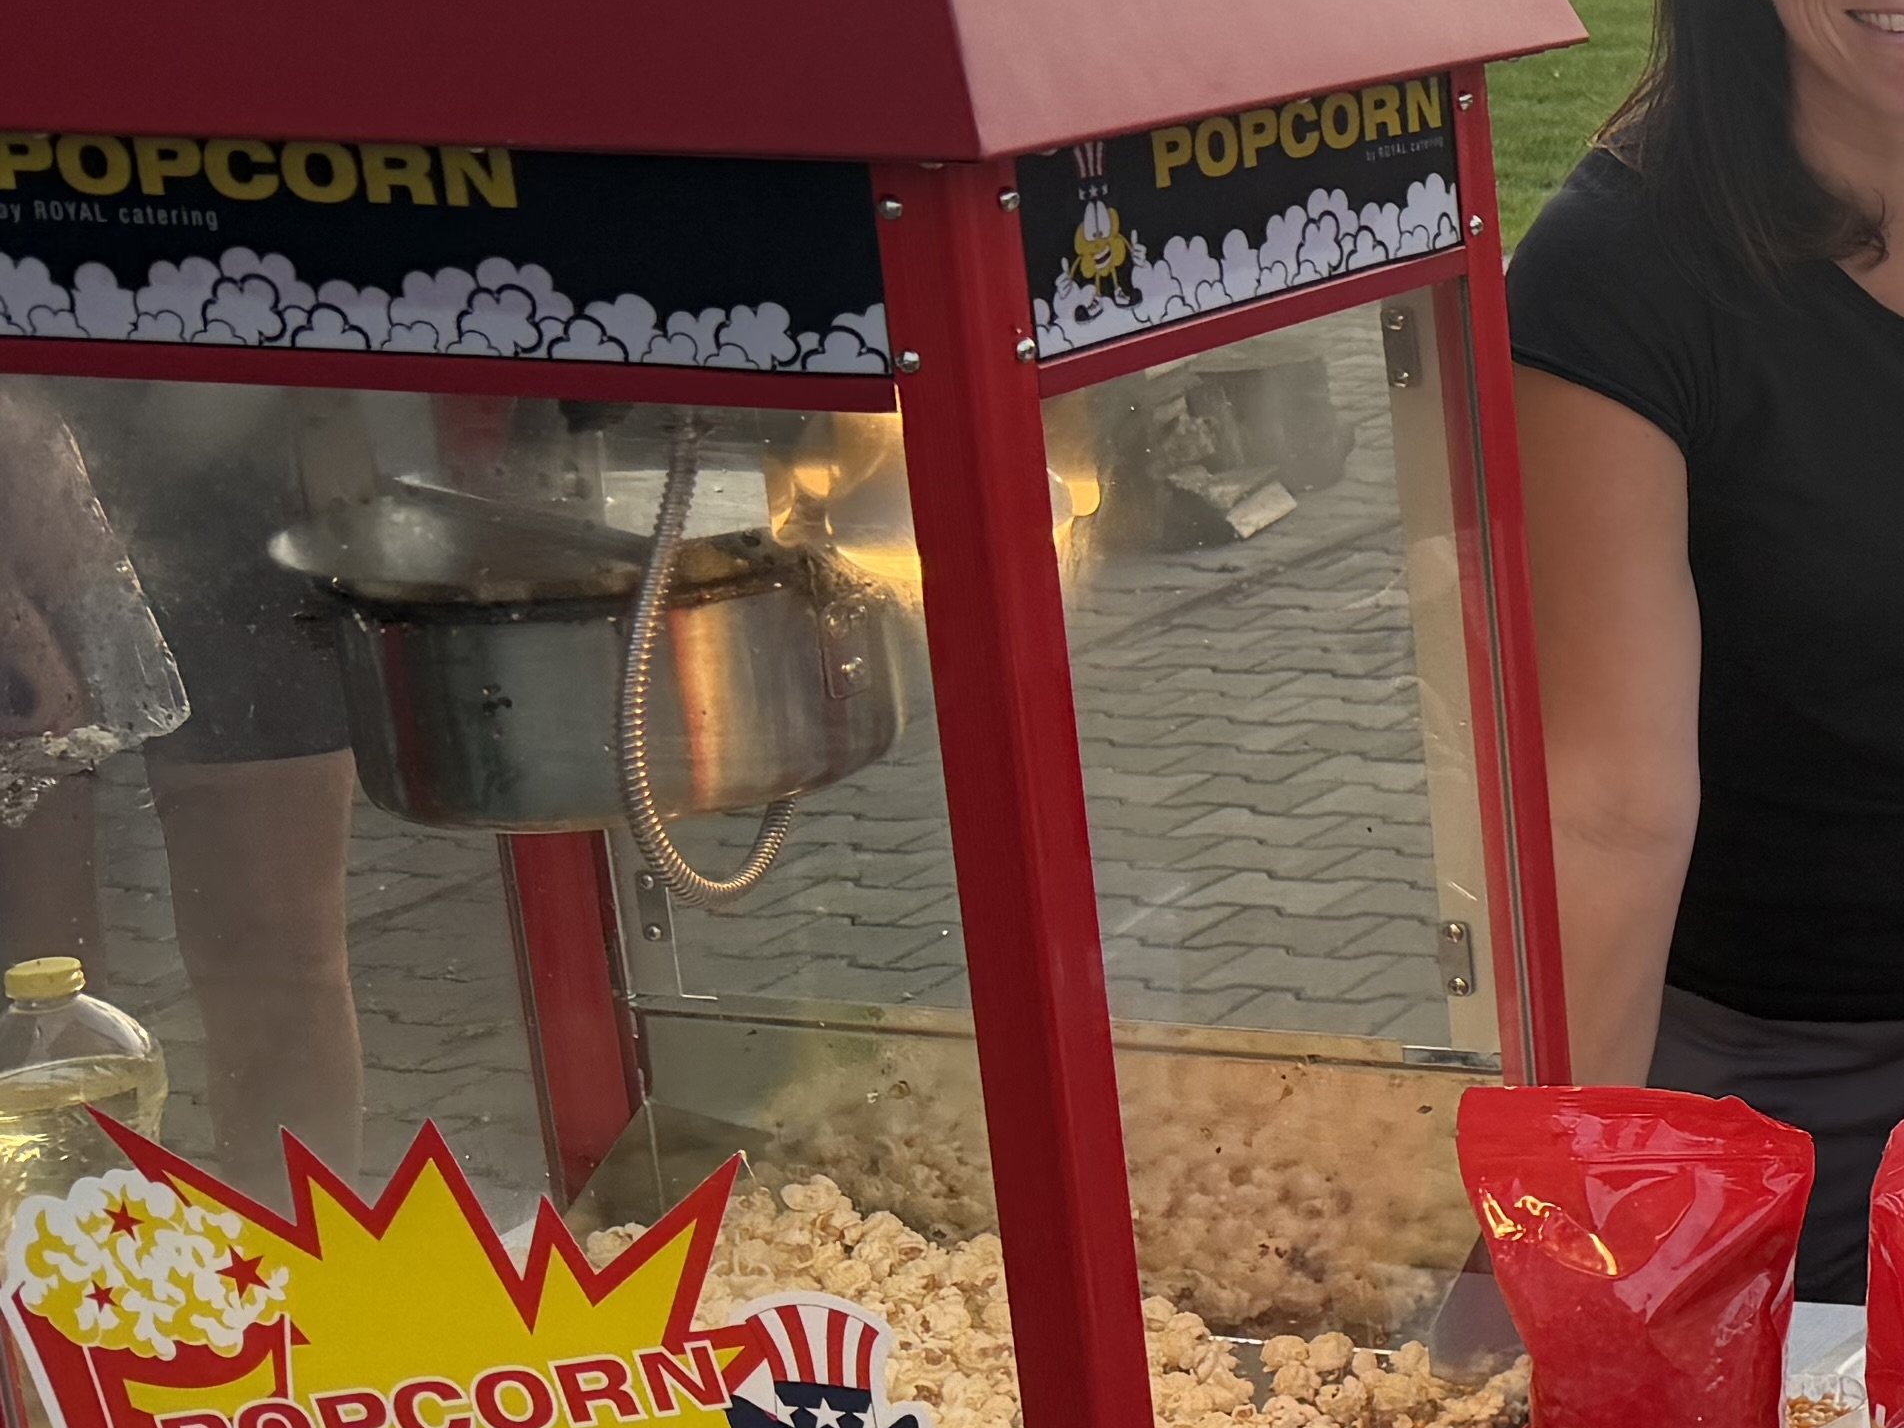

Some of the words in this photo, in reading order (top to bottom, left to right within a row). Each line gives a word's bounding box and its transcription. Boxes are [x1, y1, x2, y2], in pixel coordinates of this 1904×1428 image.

[1152, 77, 1443, 188] POPCORN
[0, 133, 518, 208] POPCORN
[33, 200, 108, 223] ROYAL
[118, 203, 219, 232] catering
